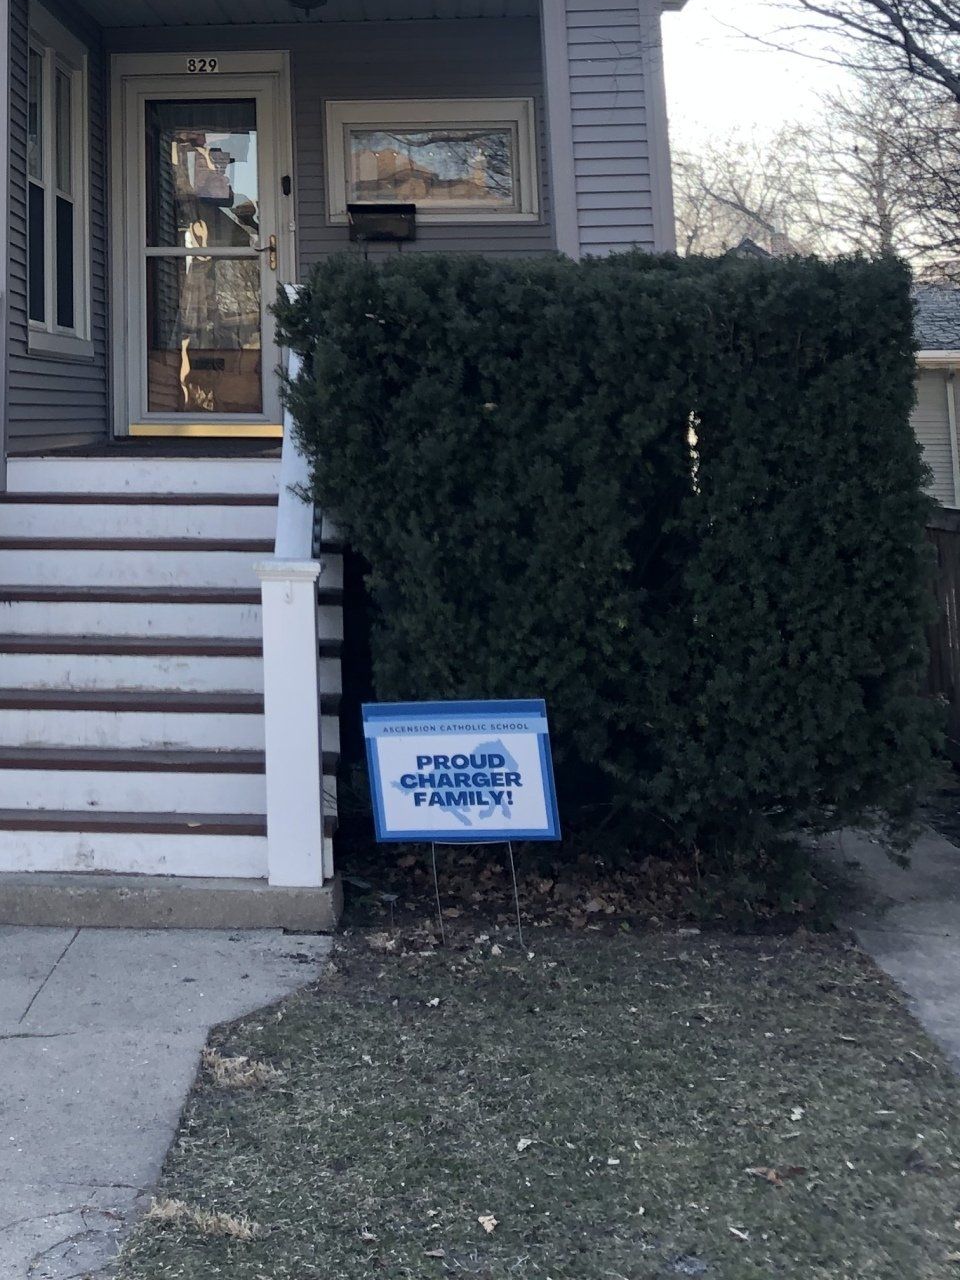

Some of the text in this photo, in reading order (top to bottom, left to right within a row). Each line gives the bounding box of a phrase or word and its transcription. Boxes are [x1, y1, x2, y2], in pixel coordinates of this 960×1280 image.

[188, 59, 217, 72] 829
[383, 723, 529, 733] ASCENSION CATHOLIC SCHOOL
[416, 754, 505, 770] PROUD
[400, 771, 523, 789] CHARGER
[414, 790, 514, 807] FAMILY!
